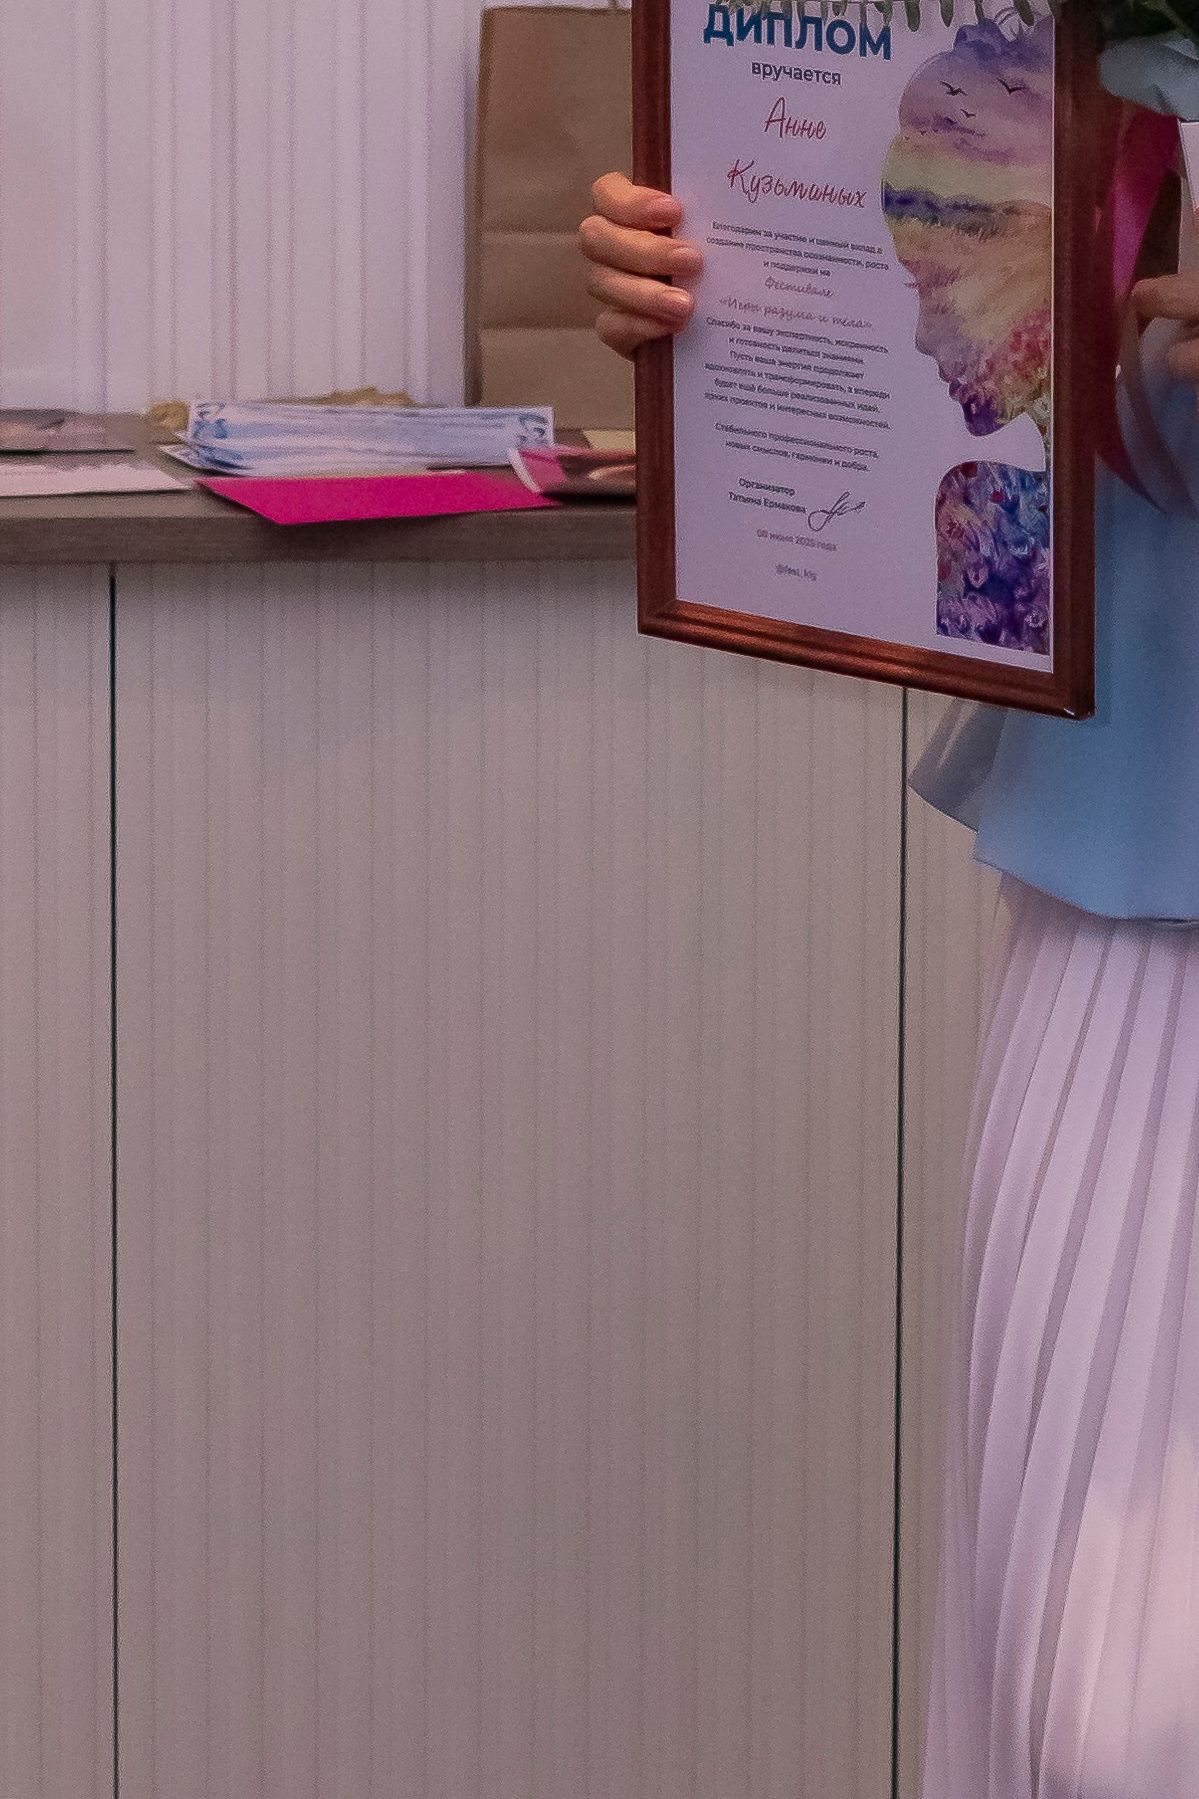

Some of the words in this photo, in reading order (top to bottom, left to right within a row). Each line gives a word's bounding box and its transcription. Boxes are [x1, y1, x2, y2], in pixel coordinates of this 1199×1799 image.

[703, 4, 892, 61] ДИПЛОМ
[751, 61, 842, 86] вручается
[764, 96, 828, 140] Анне
[763, 230, 772, 238] за
[774, 233, 807, 243] участие
[706, 236, 744, 250] создание
[745, 242, 802, 257] пространства
[865, 261, 888, 270] роста
[819, 267, 830, 277] на
[763, 302, 816, 321] разума
[818, 315, 828, 323] и
[706, 317, 740, 332] Спасибо
[742, 324, 751, 333] за
[730, 350, 753, 363] Пусть
[735, 337, 780, 352] готовность
[781, 345, 820, 358] делиться
[738, 478, 795, 497] Организатор
[728, 492, 761, 507] Татьяна
